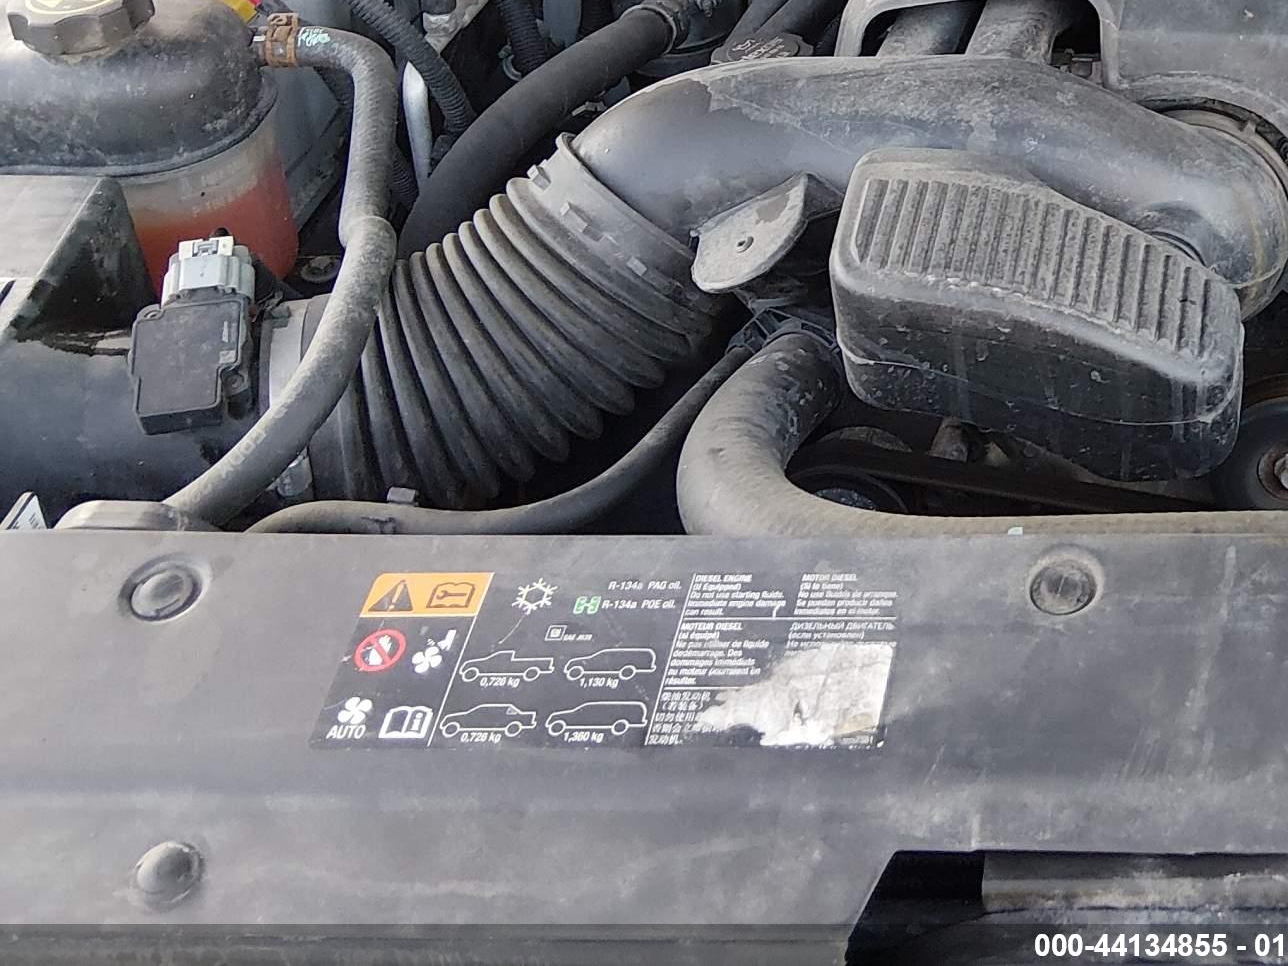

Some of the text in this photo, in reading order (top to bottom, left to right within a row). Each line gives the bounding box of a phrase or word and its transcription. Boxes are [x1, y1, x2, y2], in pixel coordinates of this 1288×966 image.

[695, 574, 753, 583] DIESEL ENGINE
[608, 581, 644, 590] R-134a
[647, 581, 667, 590] PAG
[601, 600, 638, 609] R-134a
[641, 600, 662, 609] POE
[681, 622, 743, 631] MOTEUR DIESEL
[507, 677, 520, 689] kg
[580, 676, 619, 689] 1,130 kg
[326, 724, 366, 739] AUTO
[488, 732, 502, 744] kg
[591, 732, 604, 744] kg
